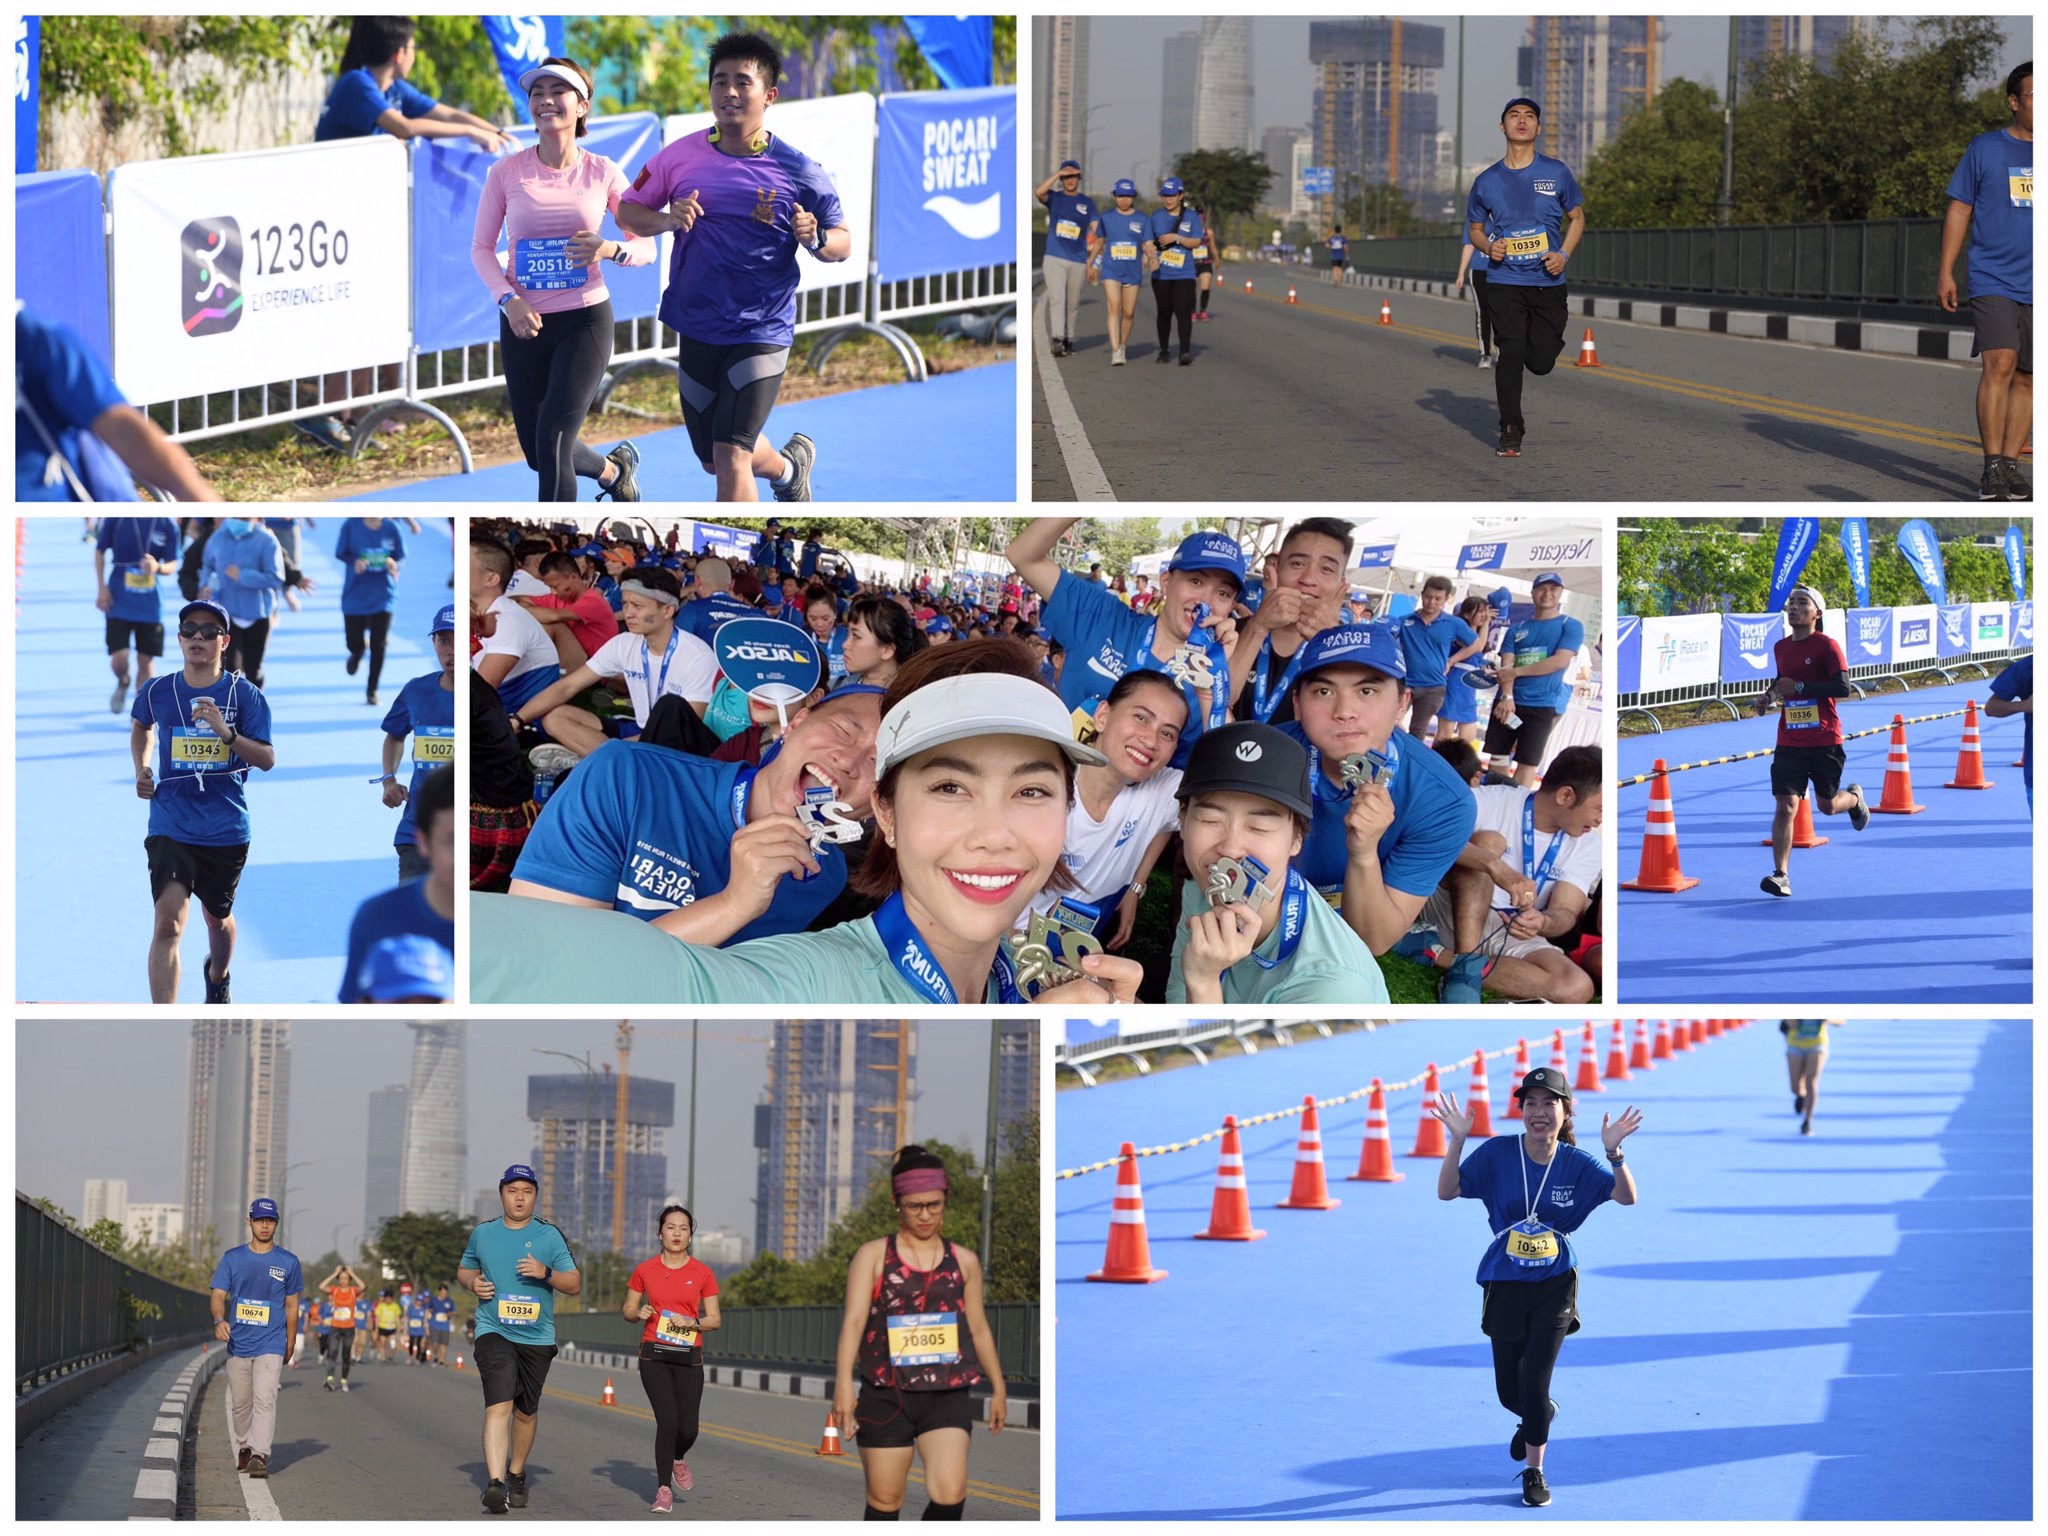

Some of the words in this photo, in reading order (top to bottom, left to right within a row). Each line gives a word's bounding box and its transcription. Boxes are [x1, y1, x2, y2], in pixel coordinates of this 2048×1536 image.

[923, 115, 997, 157] POCARI
[922, 150, 991, 193] SWEAT
[250, 220, 348, 276] 123Go
[1512, 240, 1541, 251] 10339
[528, 259, 573, 272] 20518
[252, 285, 325, 312] EXPERIENCE
[328, 281, 351, 300] LIFE
[1775, 553, 1792, 591] POCARI
[1860, 616, 1881, 628] POCARI
[1740, 623, 1767, 637] POCARI
[1860, 628, 1879, 640] SWEAT
[1739, 637, 1765, 650] SWEAT
[1789, 710, 1812, 719] 10336
[183, 744, 220, 755] 10345
[425, 744, 454, 755] 1007
[1517, 1240, 1549, 1253] 10342
[241, 1308, 263, 1317] 10674
[506, 1306, 533, 1315] 10334
[666, 1323, 691, 1336] 10335
[902, 1333, 945, 1347] 10805
